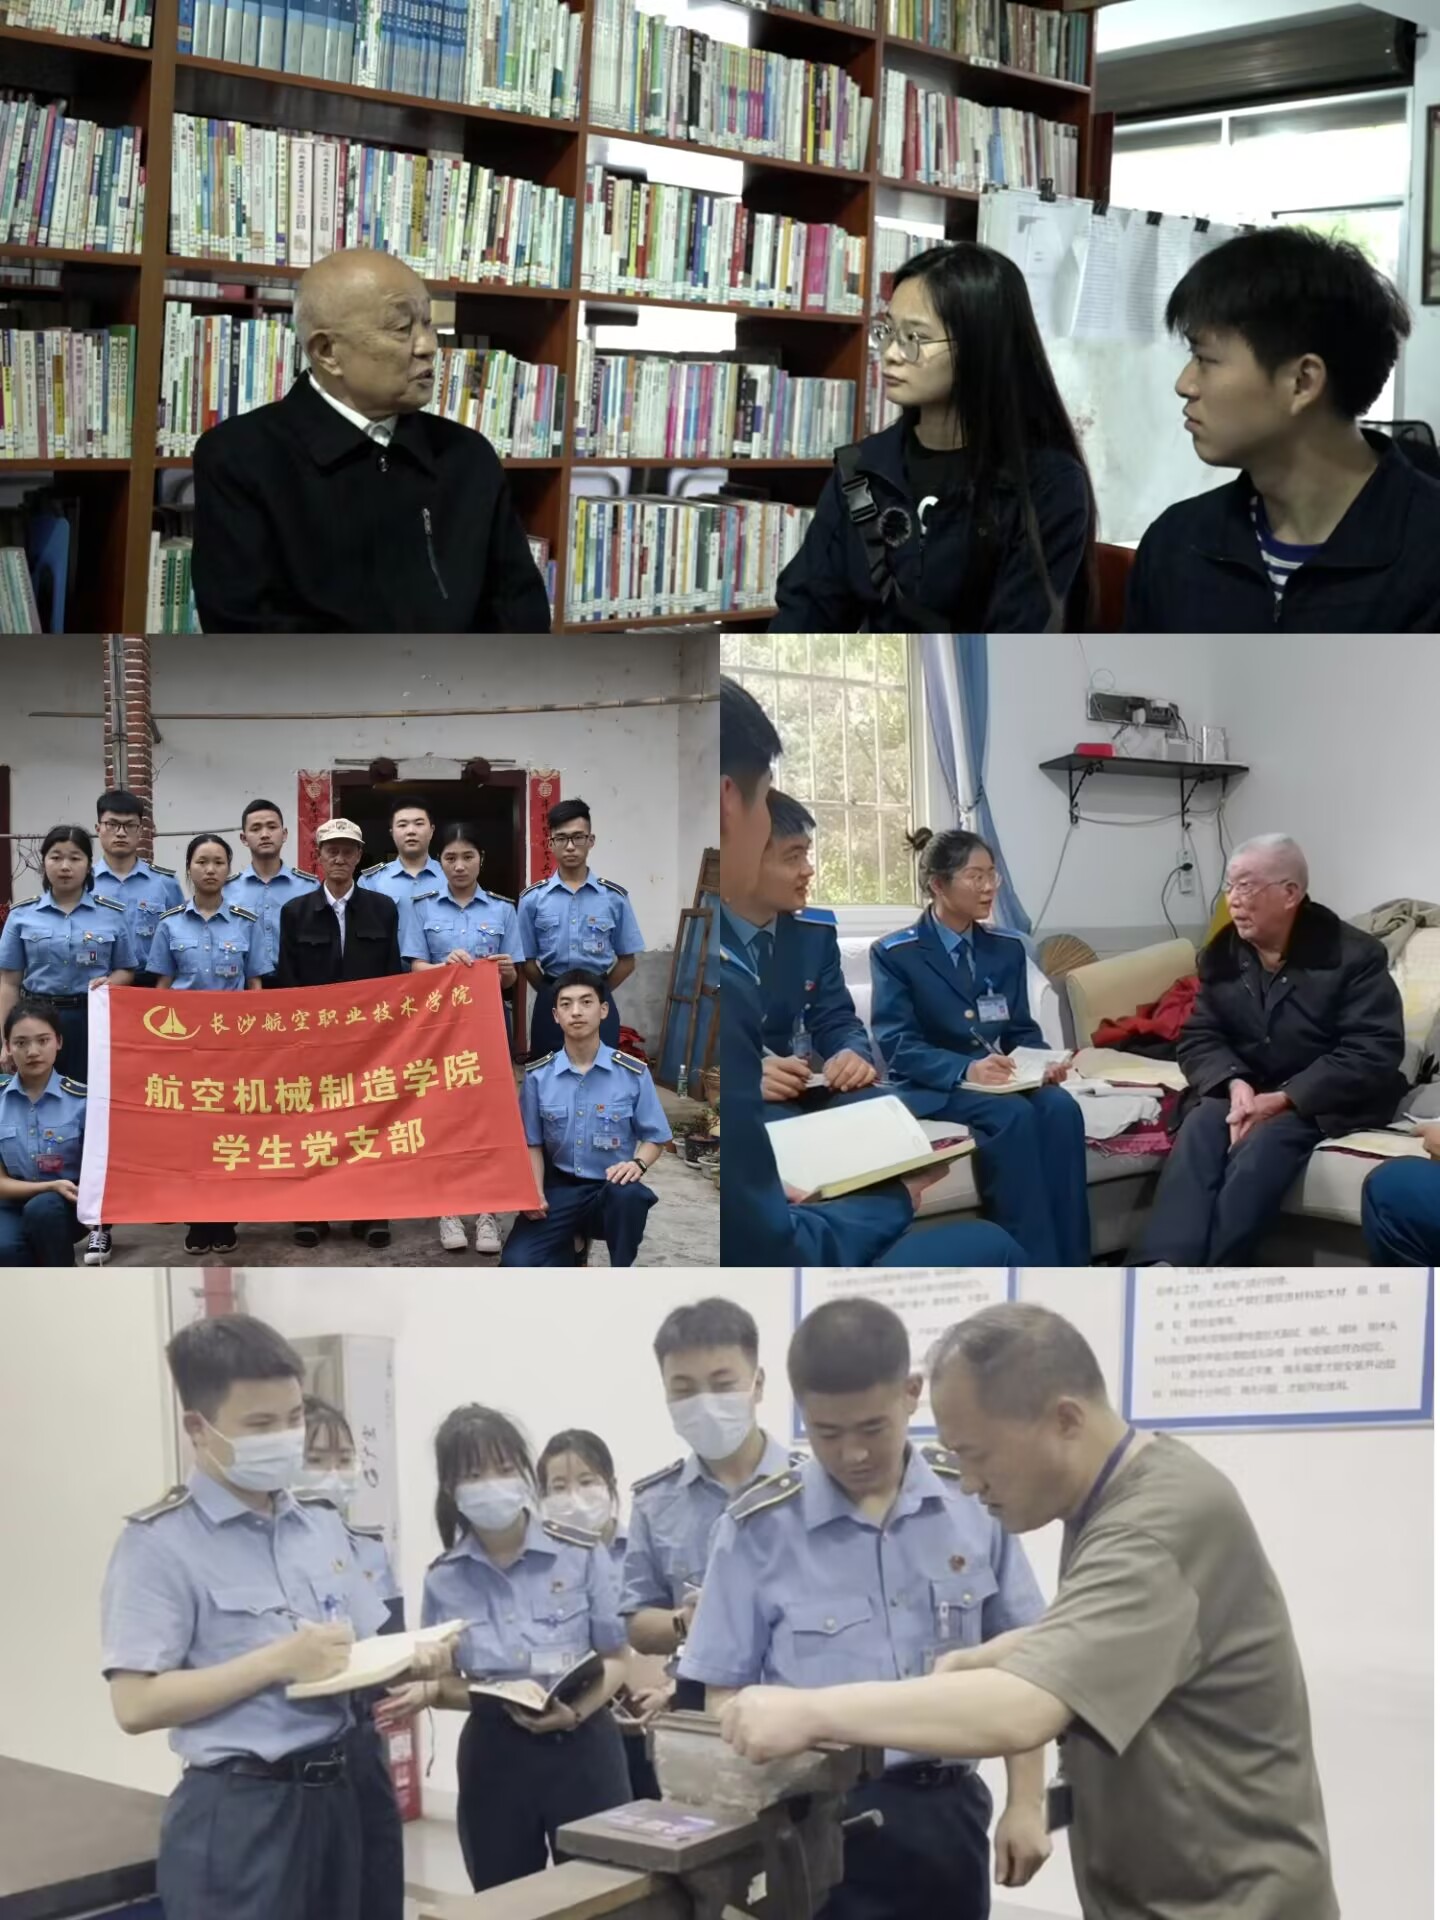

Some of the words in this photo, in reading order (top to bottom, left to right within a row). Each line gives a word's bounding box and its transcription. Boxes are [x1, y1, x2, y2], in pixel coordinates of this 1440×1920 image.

[209, 984, 473, 1036] 长沙航空职业技术学院
[144, 1049, 484, 1114] 航空机械制造学院
[212, 1118, 427, 1171] 学生党支部
